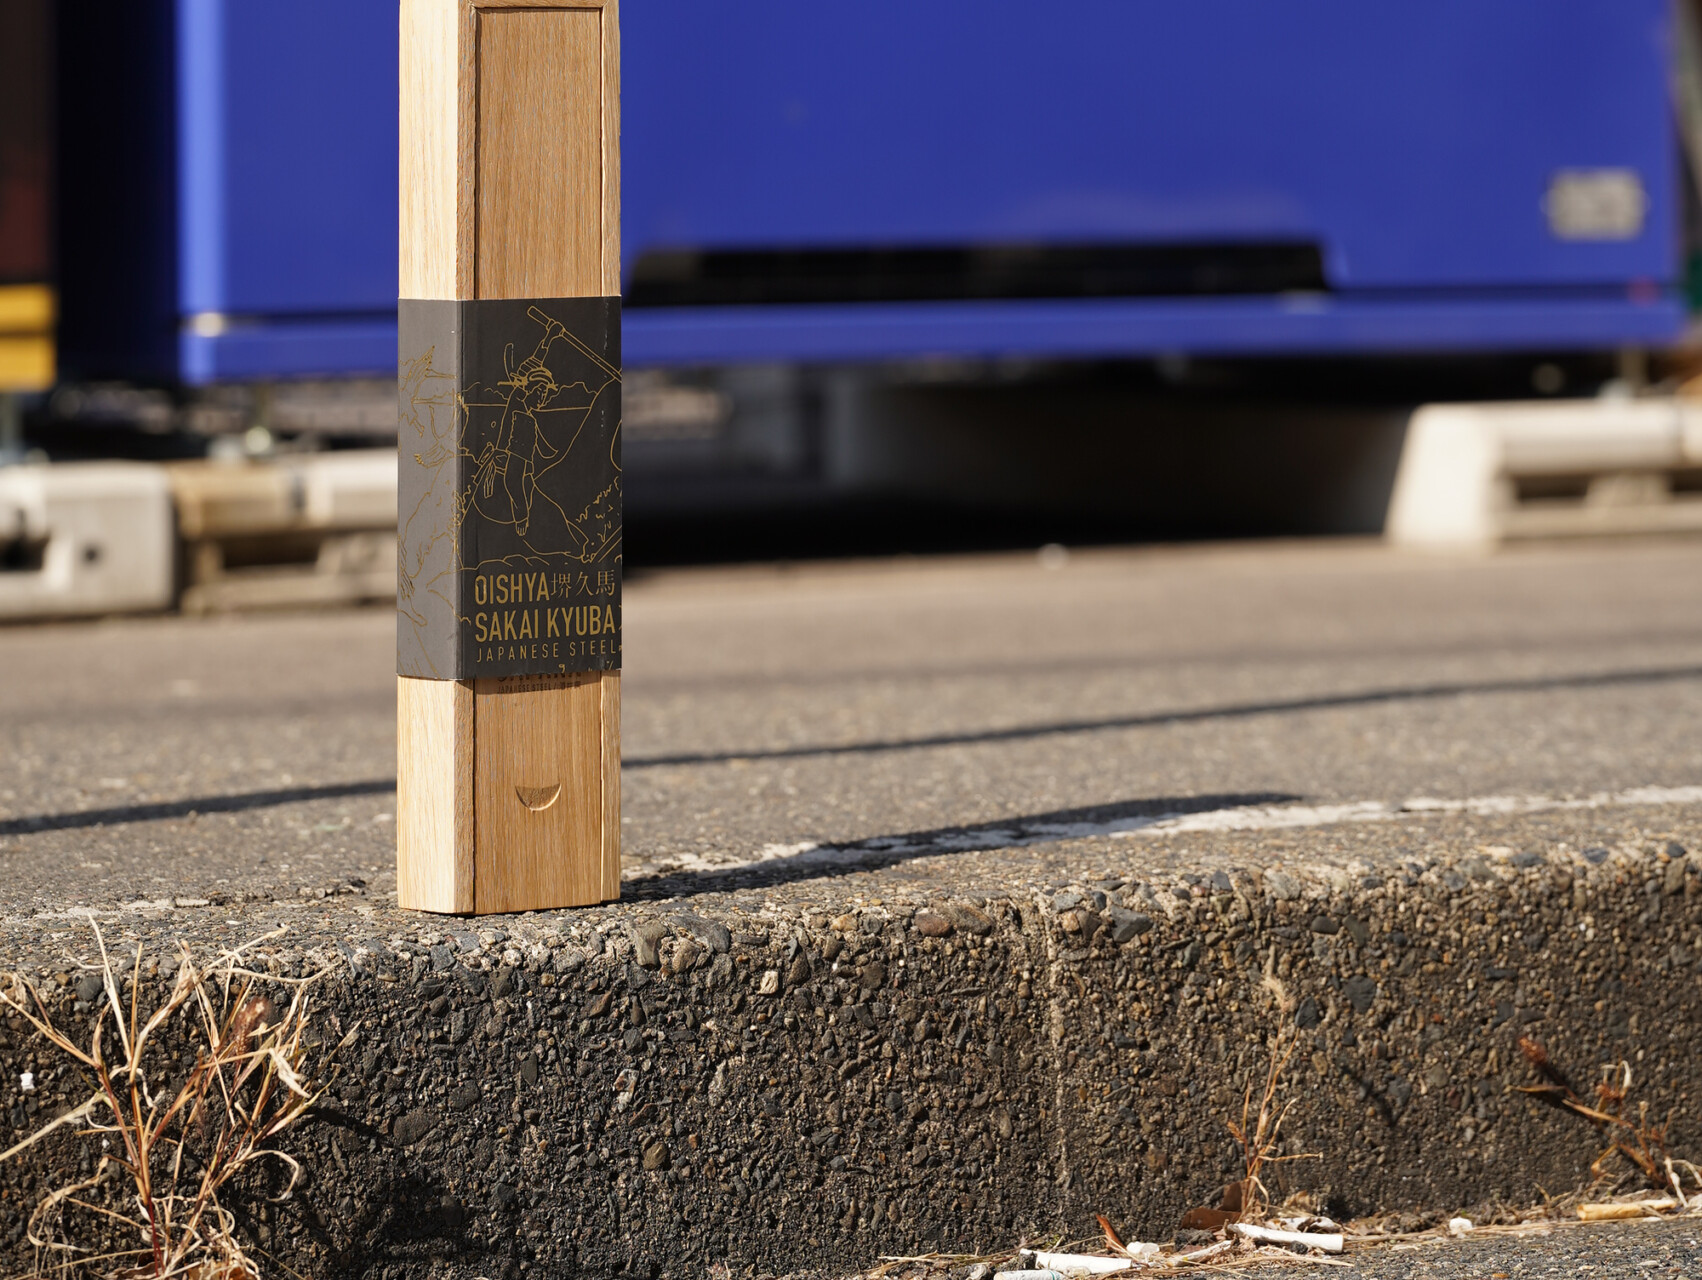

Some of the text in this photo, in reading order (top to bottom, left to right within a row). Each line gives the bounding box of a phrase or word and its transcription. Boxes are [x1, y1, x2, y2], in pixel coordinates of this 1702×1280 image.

[475, 569, 616, 605] OISHYA 堺久馬
[475, 604, 616, 643] SAKAI KYUBA
[476, 639, 616, 663] JAPANESE STEEL
